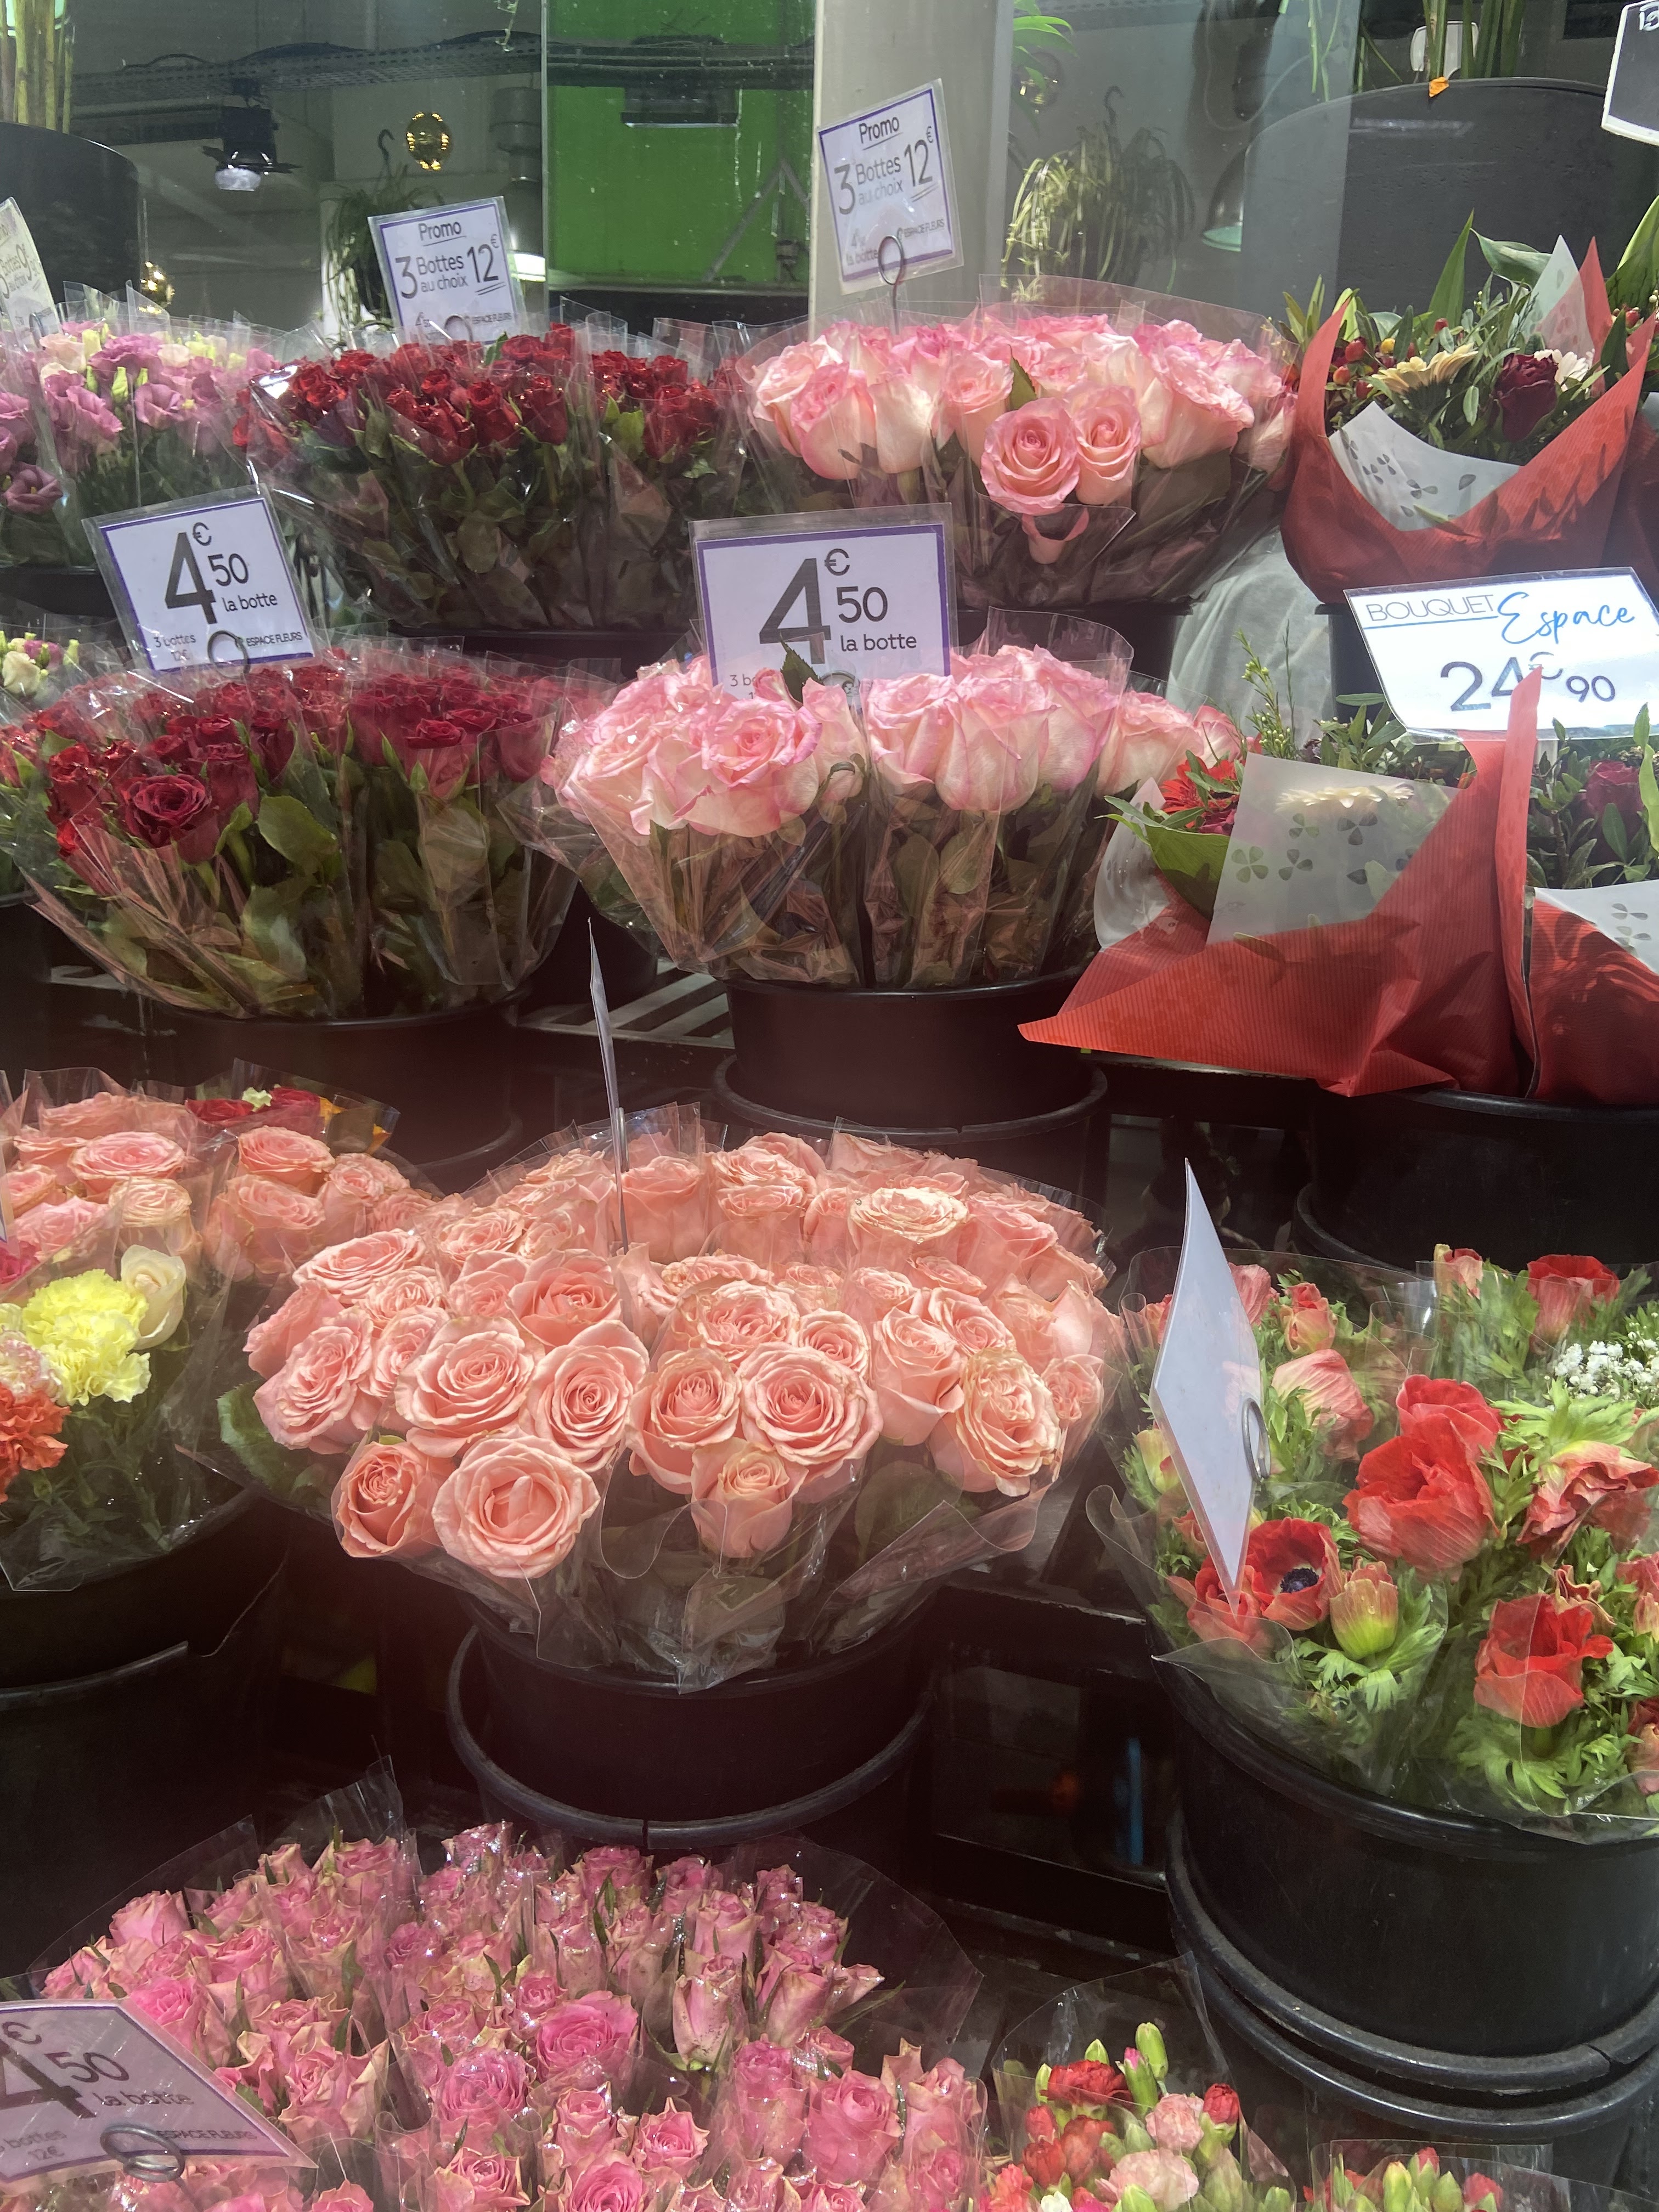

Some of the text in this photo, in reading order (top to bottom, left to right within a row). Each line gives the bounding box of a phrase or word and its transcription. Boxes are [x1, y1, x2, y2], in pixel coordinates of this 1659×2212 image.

[859, 116, 900, 144] Promo
[834, 163, 856, 216] 3
[855, 155, 901, 186] Bottes
[857, 179, 904, 207] au choix
[418, 221, 462, 241] Promo
[395, 256, 418, 300] 3
[415, 254, 465, 275] Bottes
[421, 272, 469, 293] au choix
[222, 592, 278, 613] la botte
[1365, 590, 1636, 646] BOUQUET Espace
[153, 634, 197, 648] 3 bottes
[245, 631, 303, 647] ESPACE FLEURS
[840, 634, 917, 652] la botte
[730, 674, 739, 687] 3
[93, 2091, 194, 2108] la botte
[3, 2128, 68, 2151] bottes
